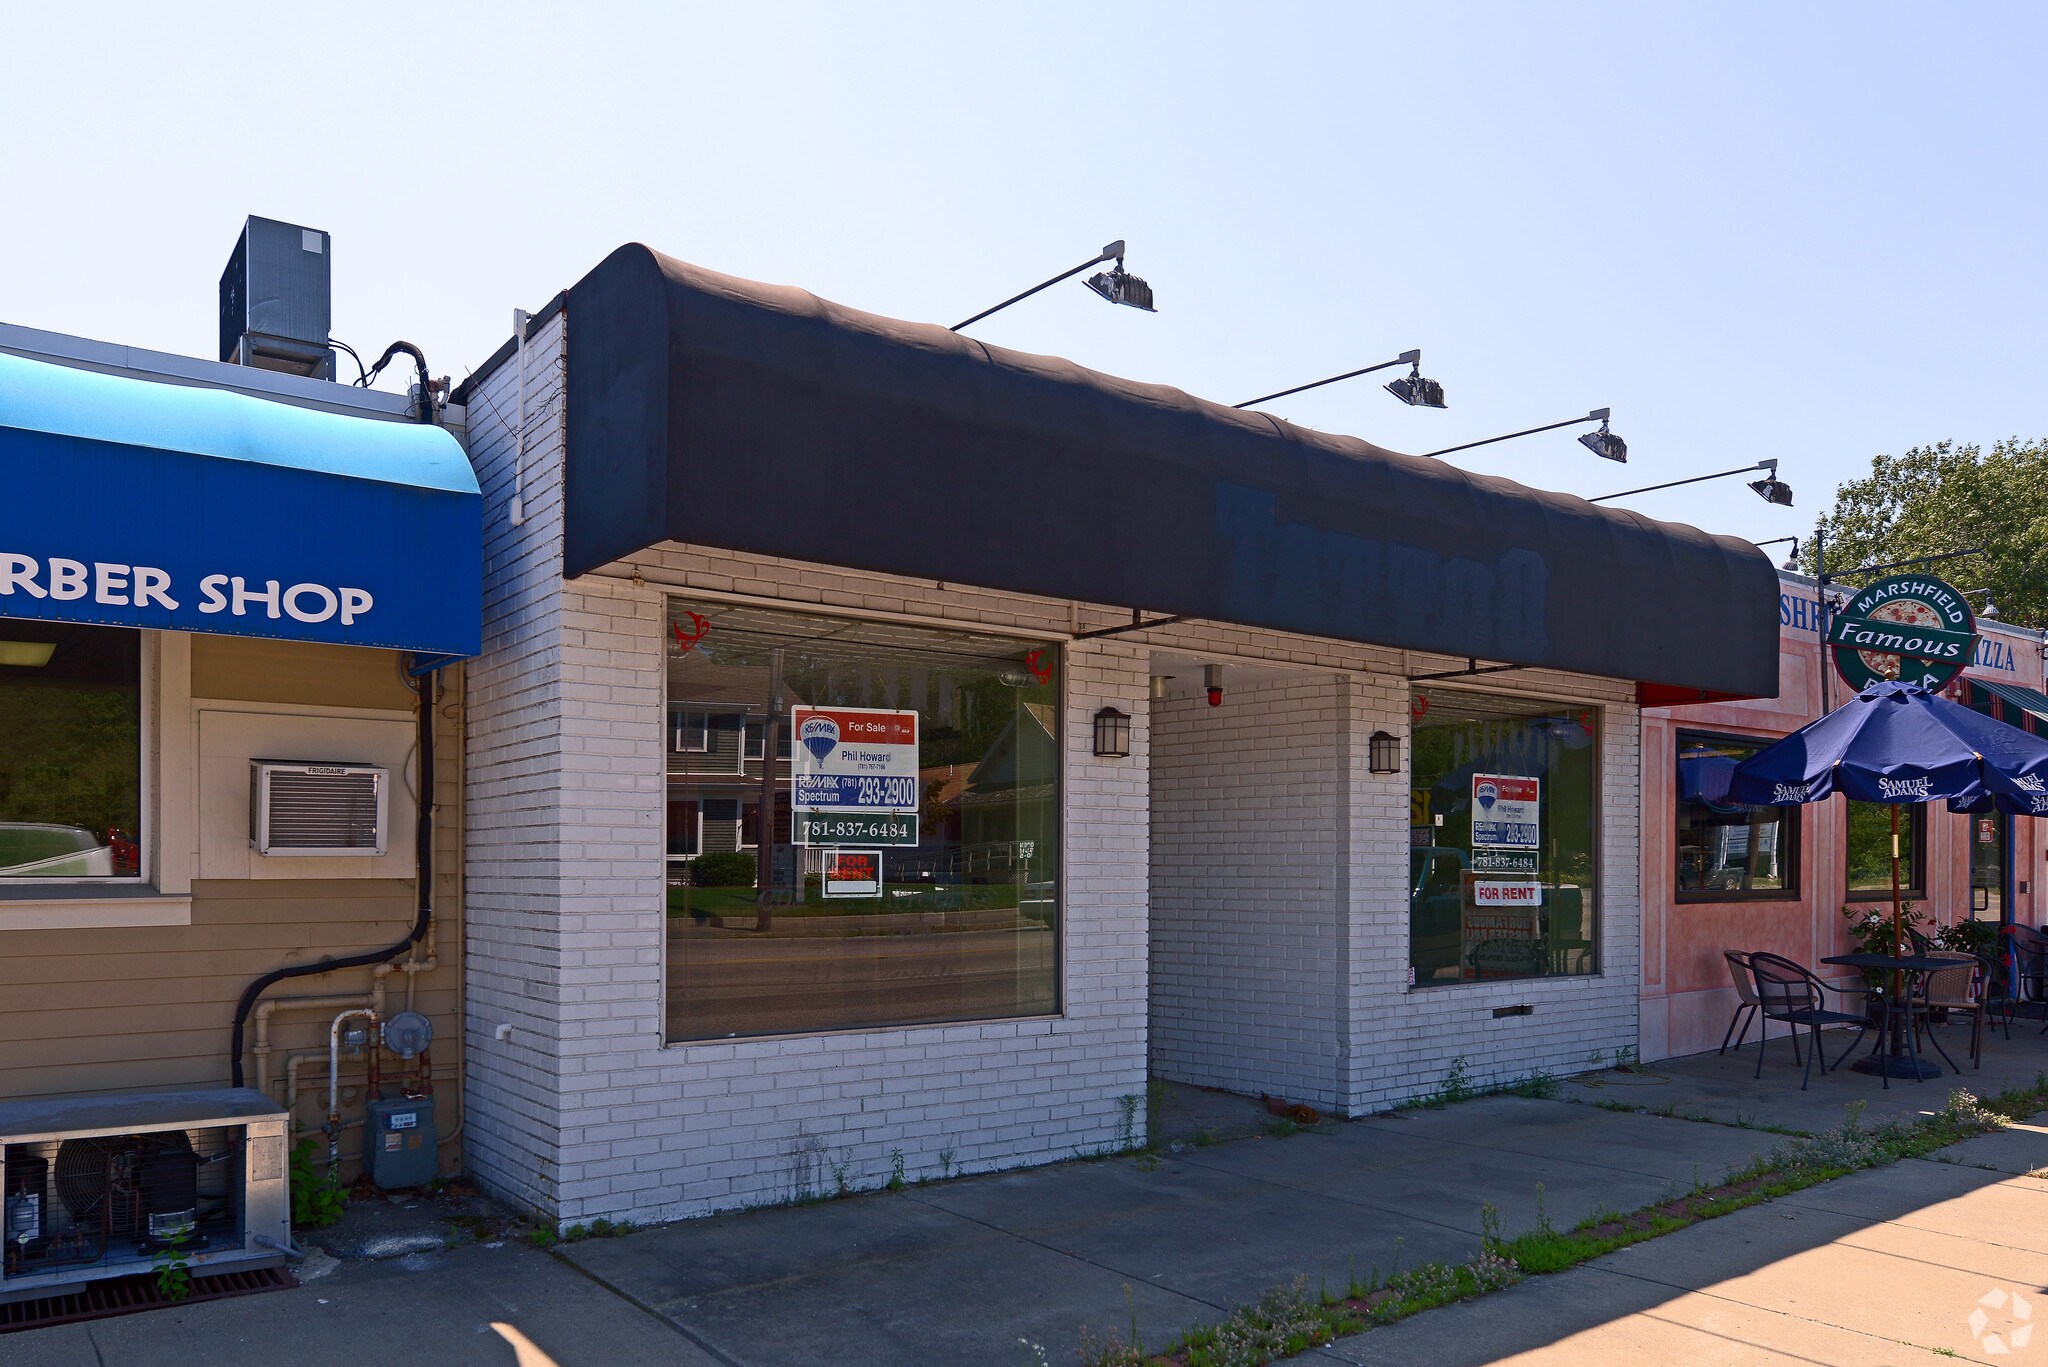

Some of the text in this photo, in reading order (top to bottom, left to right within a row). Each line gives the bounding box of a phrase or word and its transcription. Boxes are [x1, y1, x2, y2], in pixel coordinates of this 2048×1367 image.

[198, 573, 374, 625] SHOP
[1857, 581, 1964, 625] MARSHFIELD
[1839, 621, 1960, 657] Famous
[804, 721, 836, 735] RE/MAX
[848, 721, 864, 732] For
[866, 722, 886, 733] Sale
[841, 750, 891, 762] Phil Howard
[308, 767, 346, 775] FRIGIDAIRE
[798, 775, 839, 789] RE/MAX
[1878, 776, 1934, 790] SAMUEL
[798, 789, 840, 804] Spectrum
[841, 776, 915, 805] (781) 293-2900
[1773, 783, 1811, 797] SAMUEL
[1883, 788, 1928, 799] ADAMS
[1770, 792, 1806, 804] ADAMS
[802, 821, 908, 838] 781-837-6484
[837, 855, 868, 867] FOR
[1477, 856, 1534, 868] 781-837-6484
[1478, 887, 1536, 900] FOR RENT
